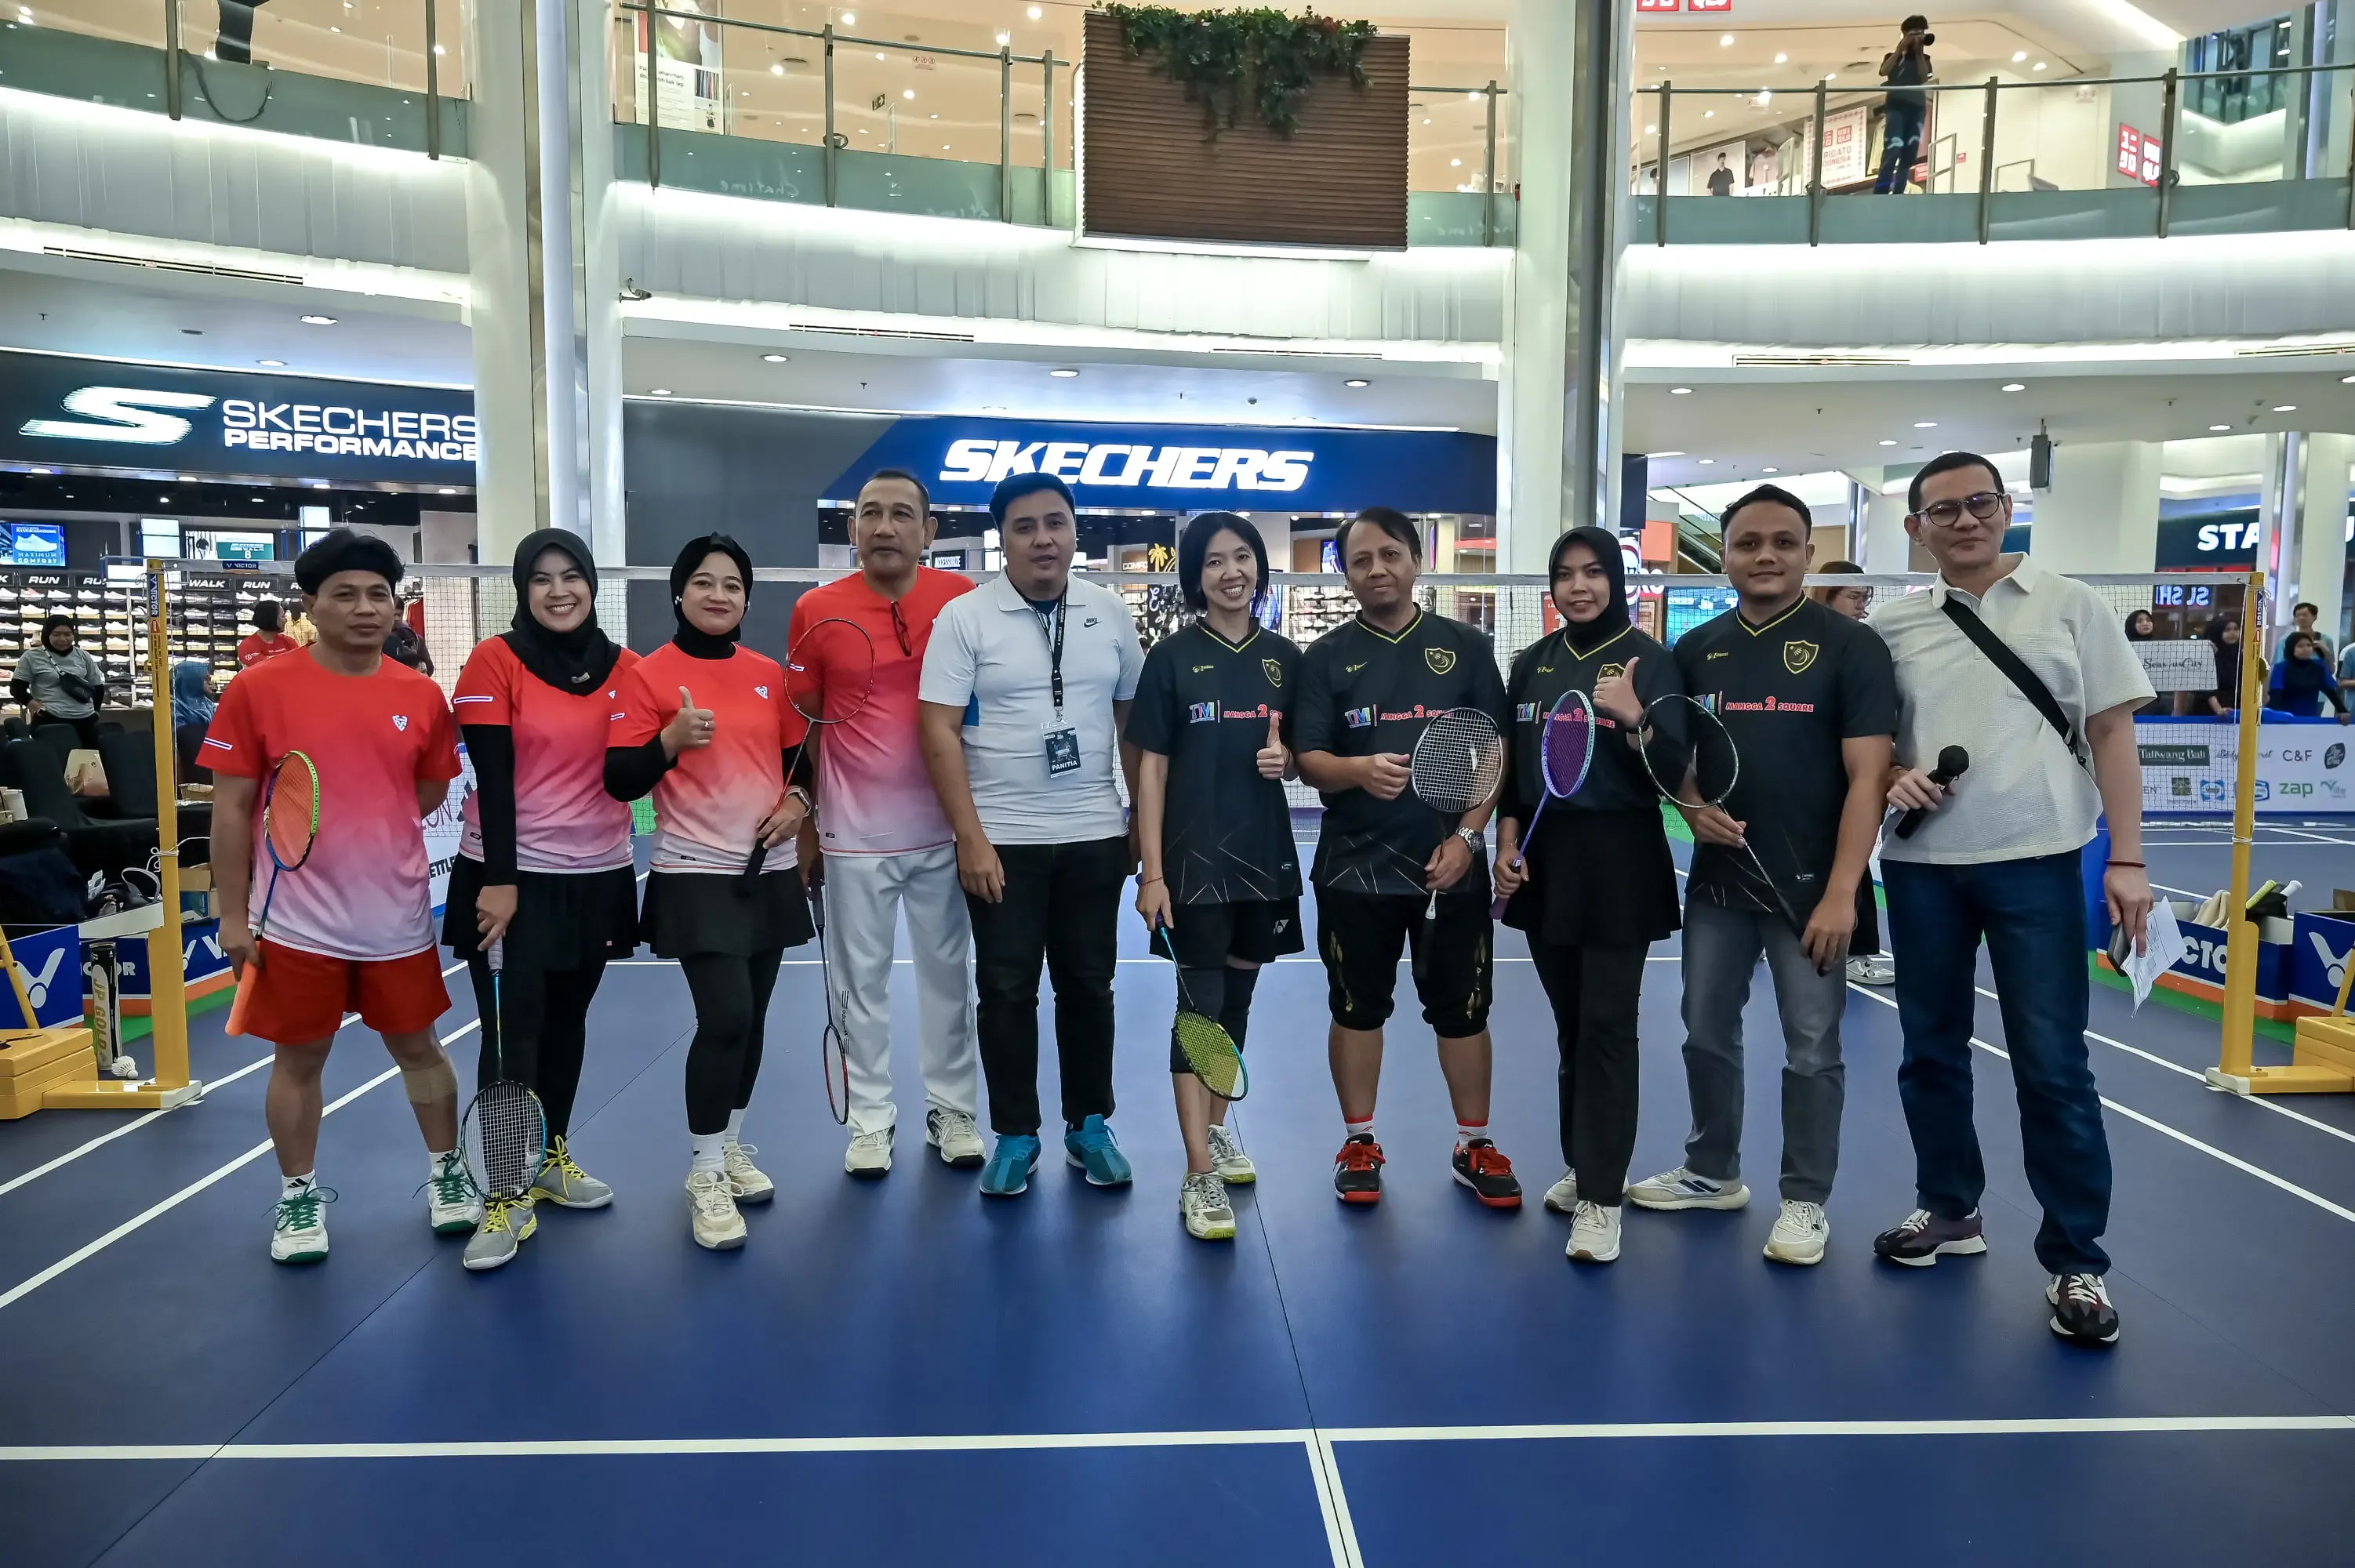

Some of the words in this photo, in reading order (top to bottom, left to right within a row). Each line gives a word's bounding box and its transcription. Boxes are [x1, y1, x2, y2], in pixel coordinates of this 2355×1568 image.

[223, 398, 477, 443] SKECHERS
[224, 428, 477, 461] PERFORMANCE
[939, 439, 1314, 492] SKECHERS
[1189, 702, 1215, 720] TM
[1257, 704, 1268, 717] 2
[1380, 711, 1413, 720] MANGGA
[1414, 705, 1424, 718] 2
[1726, 702, 1763, 710] MANGGA
[1764, 696, 1775, 710] 2
[1777, 702, 1814, 713] SQUARE
[1543, 711, 1572, 721] MNGGA
[1573, 707, 1583, 721] 2
[1583, 714, 1615, 729] SUARE
[1052, 760, 1078, 771] PANITIA
[2282, 750, 2313, 762] C&F
[2279, 782, 2313, 798] zap
[2180, 935, 2228, 974] CTO
[93, 979, 106, 1002] JP
[95, 1007, 107, 1051] GOLD
